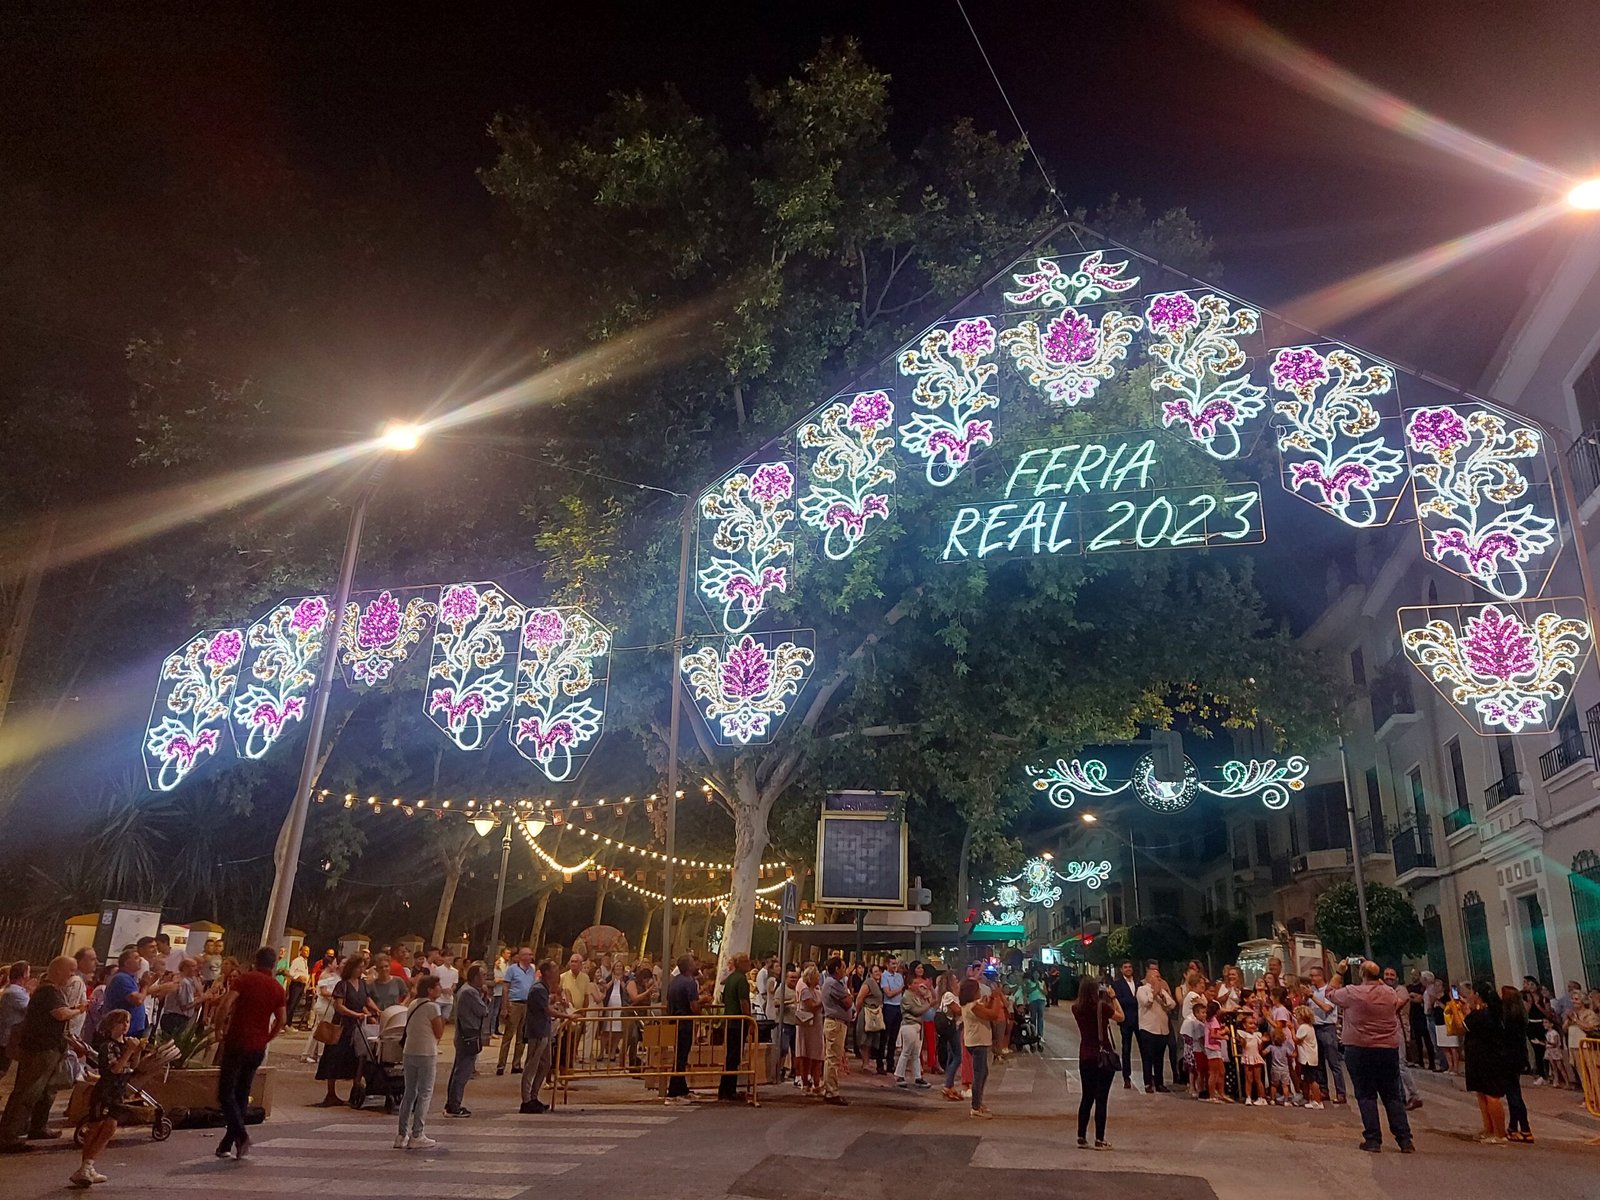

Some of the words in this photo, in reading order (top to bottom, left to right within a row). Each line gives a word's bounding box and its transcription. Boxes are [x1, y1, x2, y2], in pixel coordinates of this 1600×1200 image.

[1004, 440, 1156, 499] FERIA
[943, 501, 1072, 560] REAL
[1090, 491, 1258, 551] 2023
